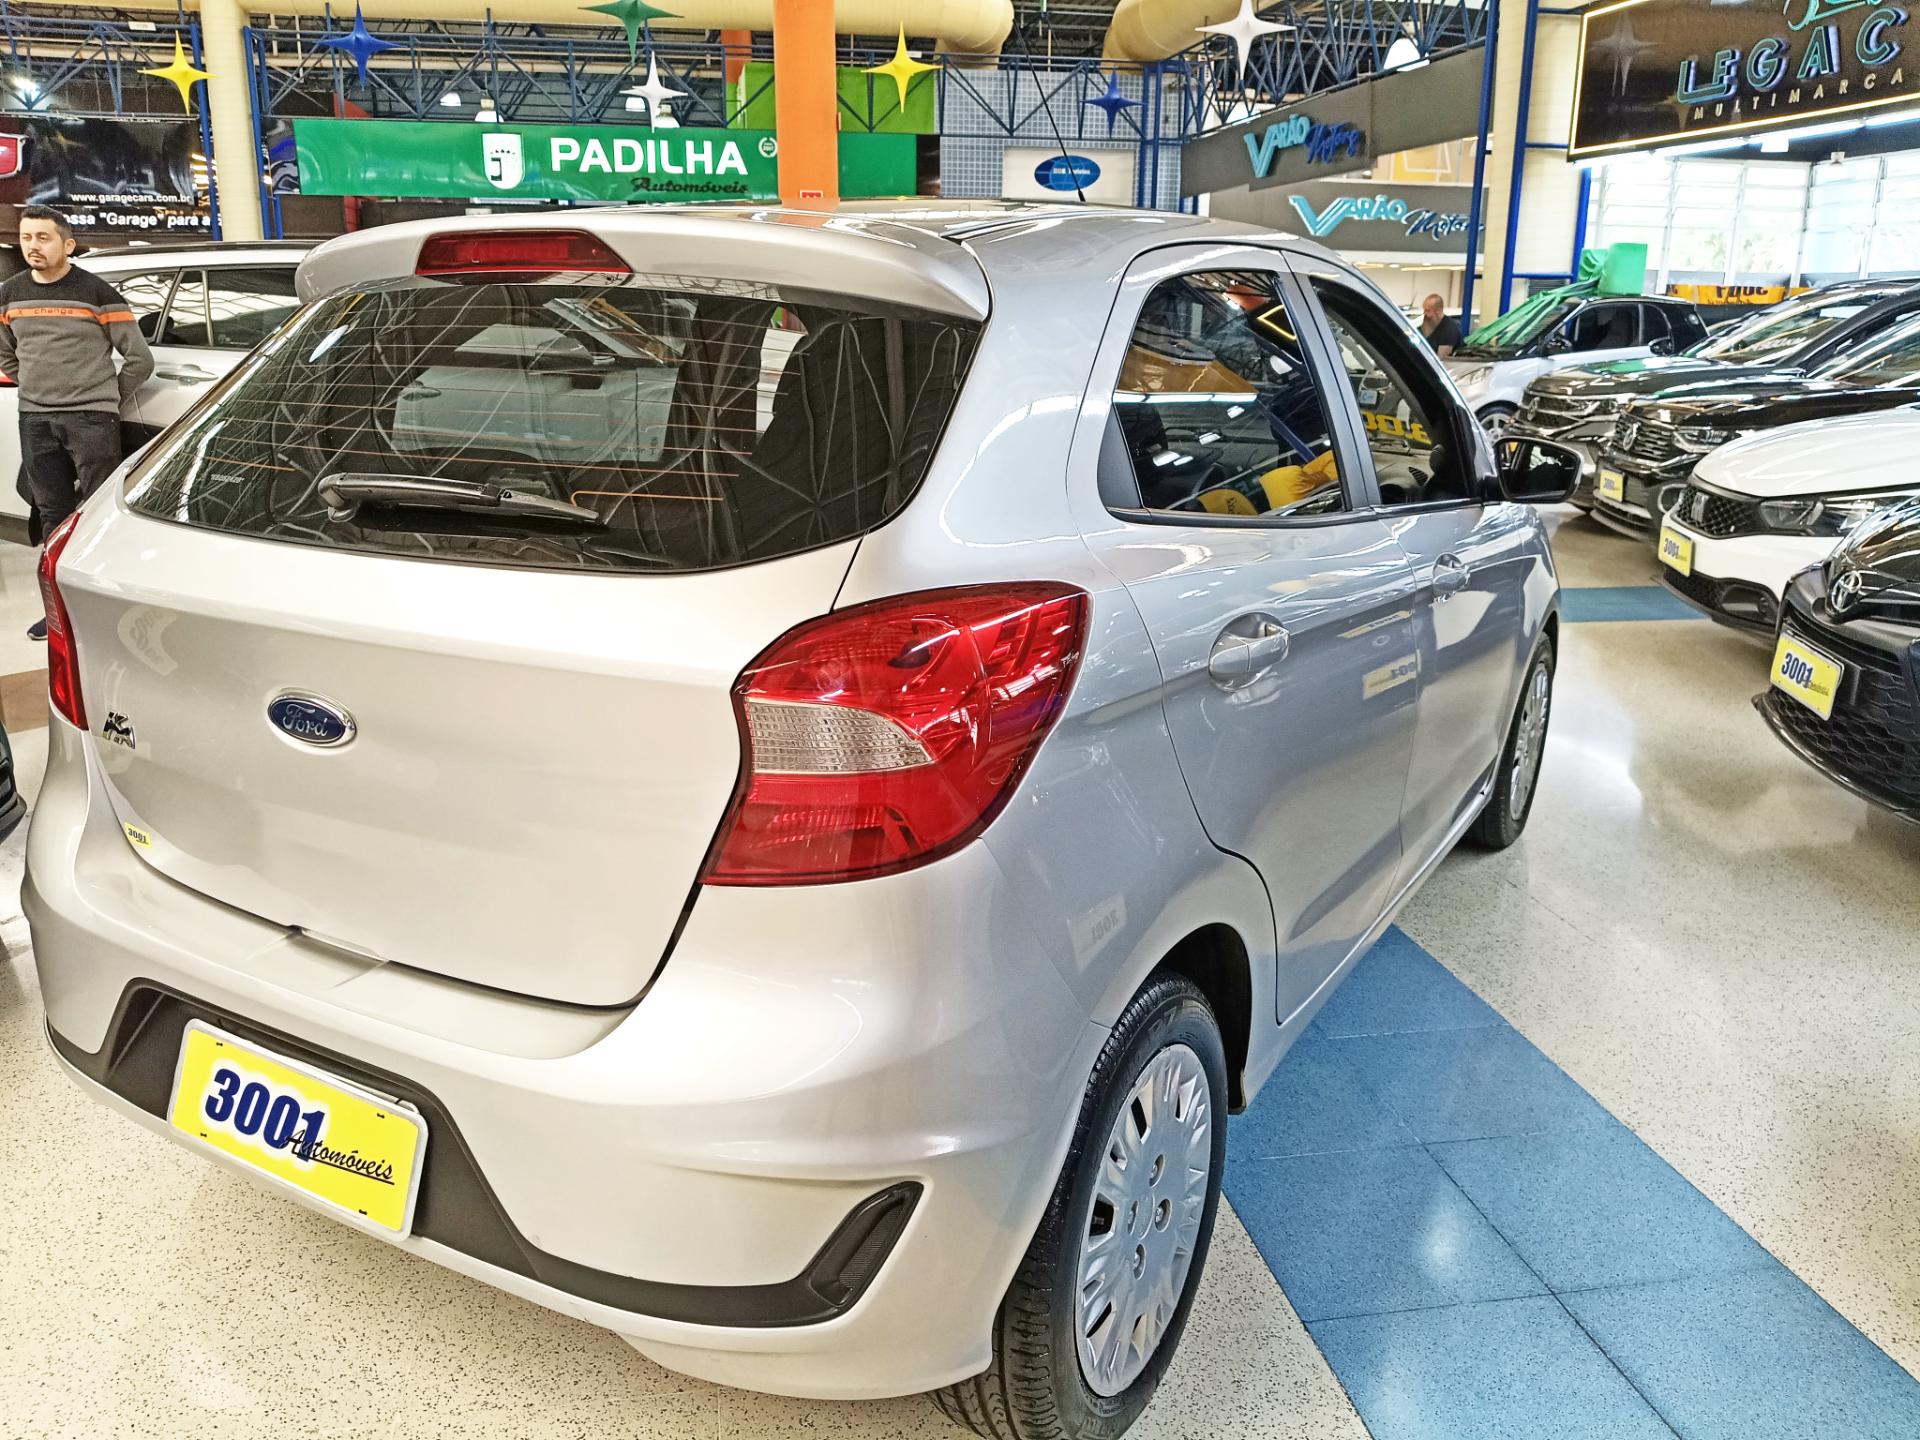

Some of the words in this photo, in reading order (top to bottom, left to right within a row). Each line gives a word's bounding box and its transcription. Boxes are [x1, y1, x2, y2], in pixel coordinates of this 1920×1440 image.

[1694, 68, 1902, 120] MULTIMARCA
[550, 137, 748, 175] PADILHA
[1244, 114, 1310, 178] VARÃO
[70, 193, 191, 204] www.garagecars.com.br
[631, 177, 748, 193] Automóveis
[167, 215, 199, 228] para
[1289, 194, 1408, 236] VARÃO
[1781, 652, 1813, 689] 3001
[282, 703, 328, 737] Ford
[204, 1068, 326, 1163] 3001
[280, 1129, 396, 1182] Automóveis
